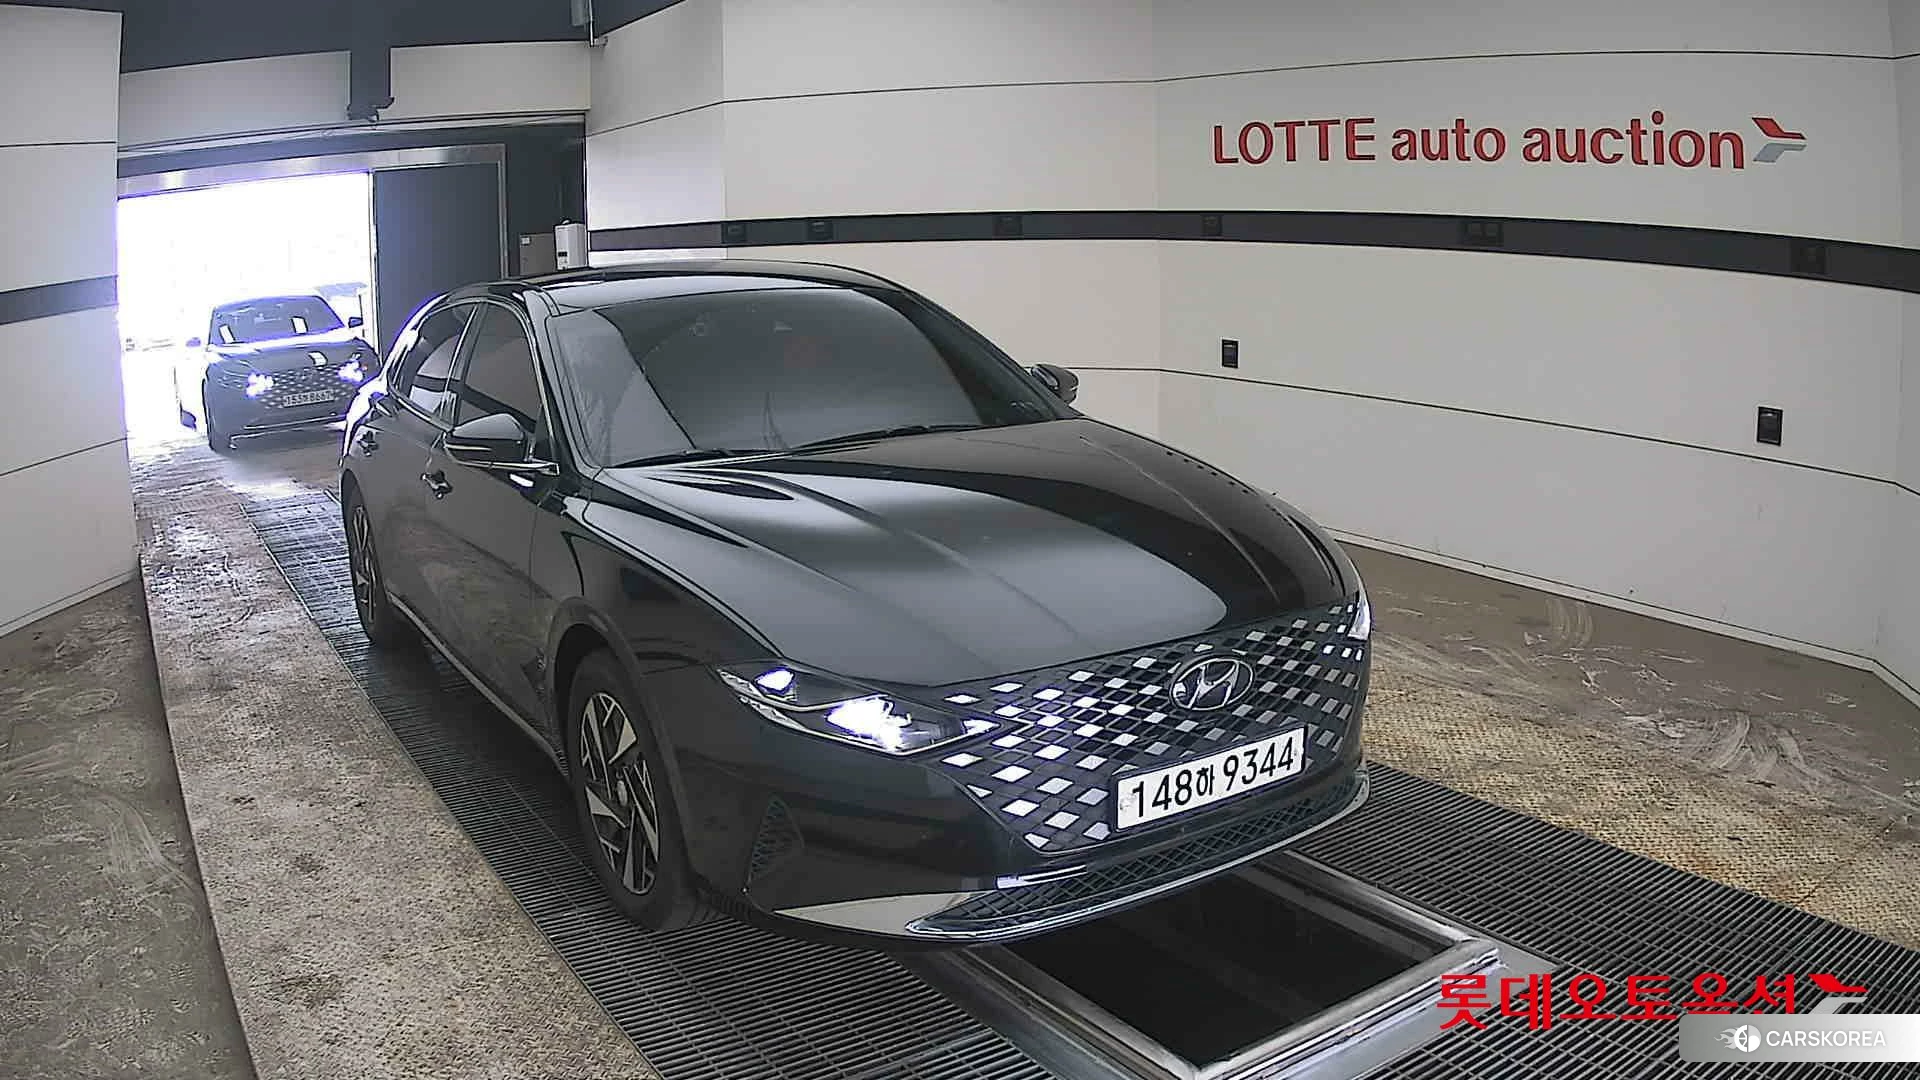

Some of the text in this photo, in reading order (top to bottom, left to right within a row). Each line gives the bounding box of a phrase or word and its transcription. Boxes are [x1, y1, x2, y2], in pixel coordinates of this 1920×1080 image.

[1212, 110, 1745, 170] LOTTE auto auction
[1223, 736, 1294, 791] 9344
